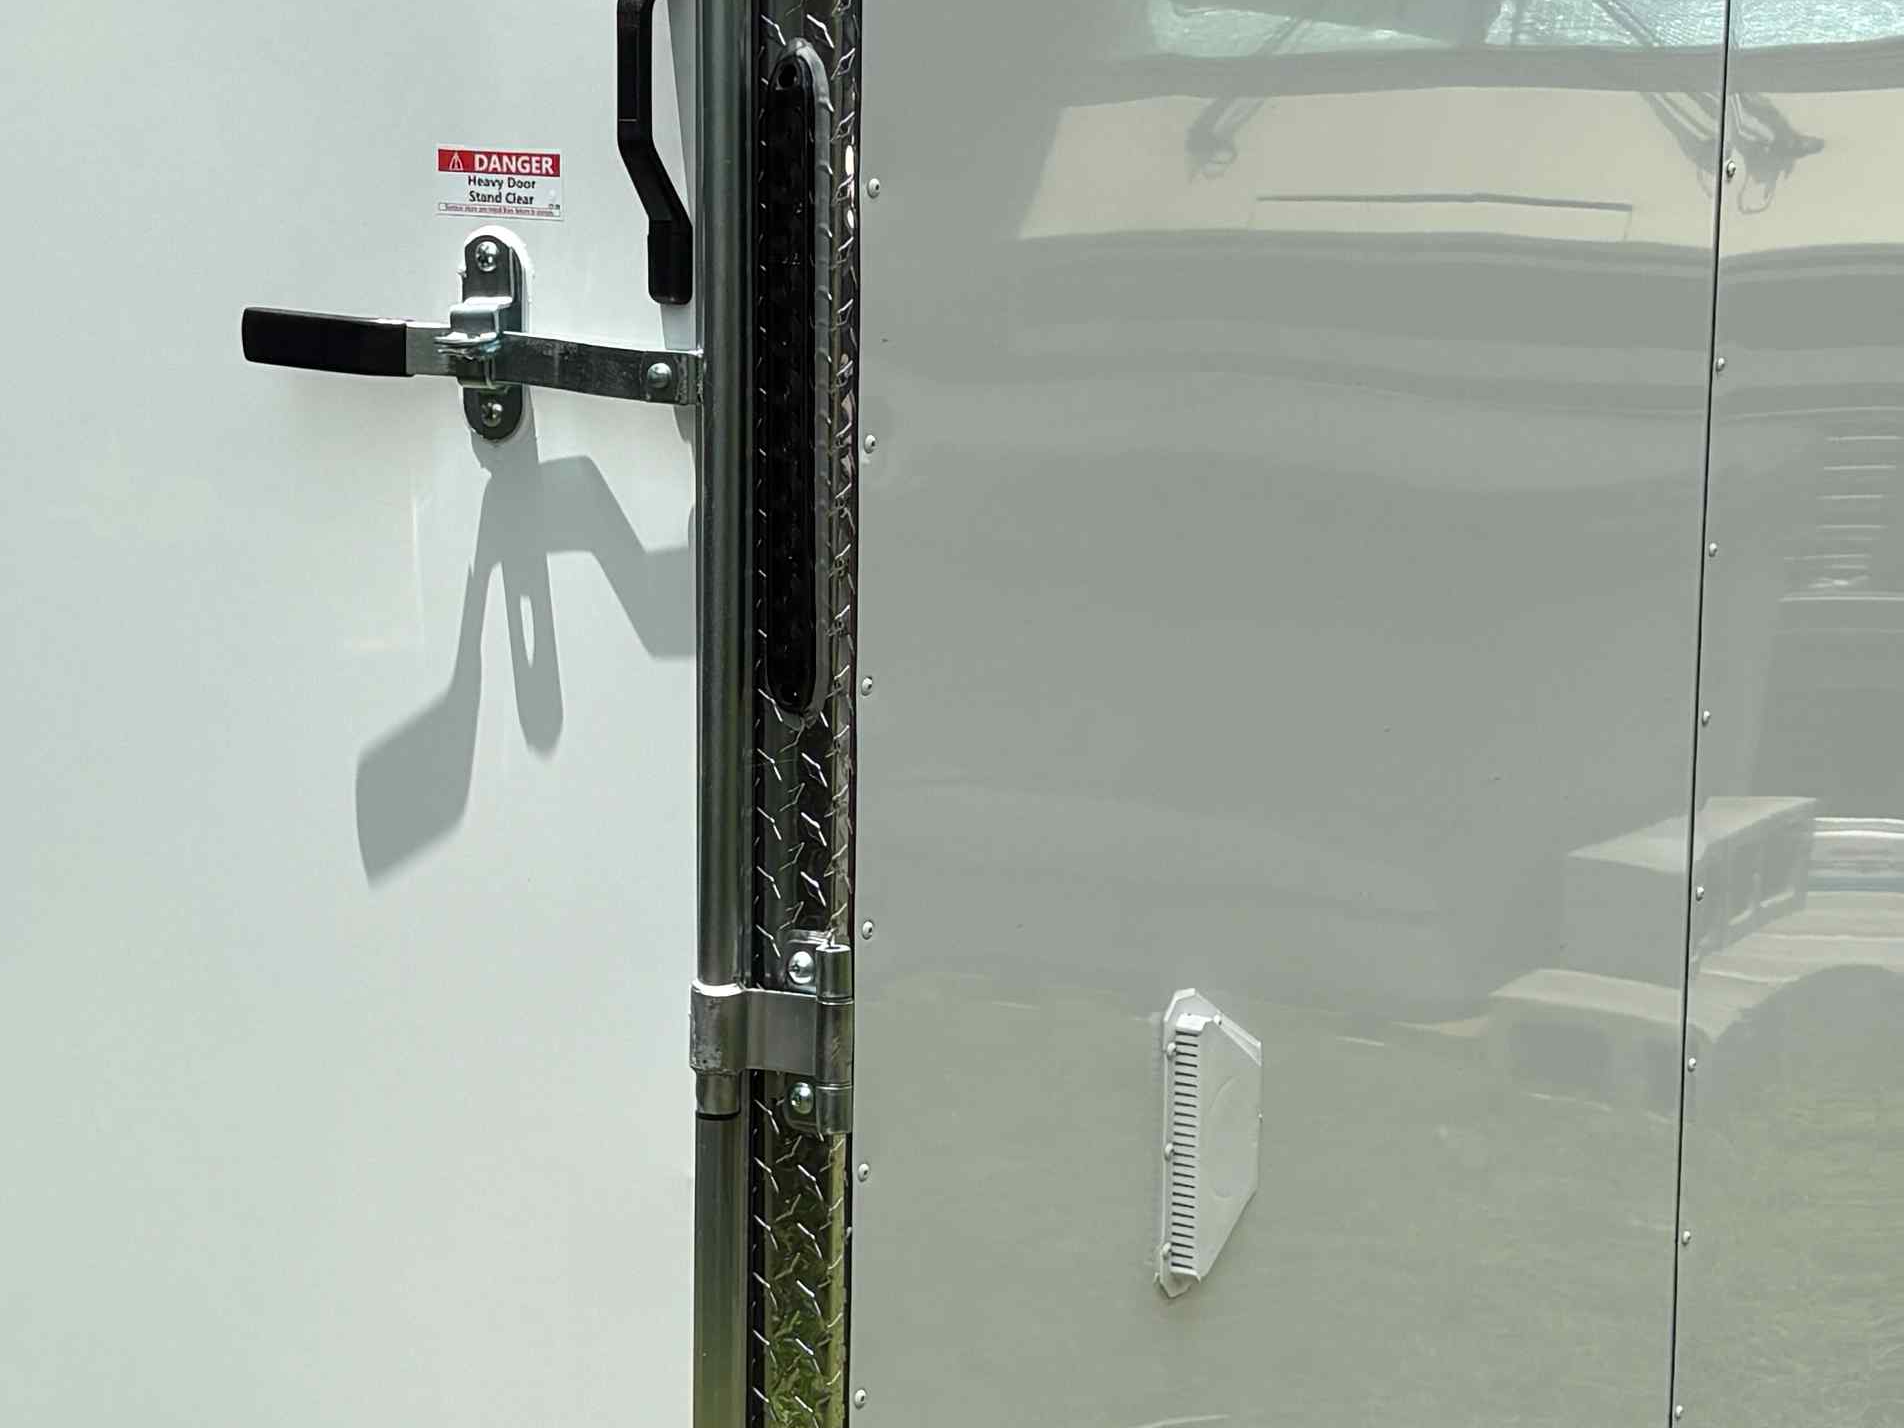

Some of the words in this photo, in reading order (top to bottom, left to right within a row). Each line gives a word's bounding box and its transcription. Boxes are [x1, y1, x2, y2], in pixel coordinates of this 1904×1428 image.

[473, 153, 555, 175] DANGER
[467, 175, 505, 190] Heavy
[507, 177, 536, 189] Door
[468, 190, 502, 204] Stand
[504, 191, 534, 205] Clear
